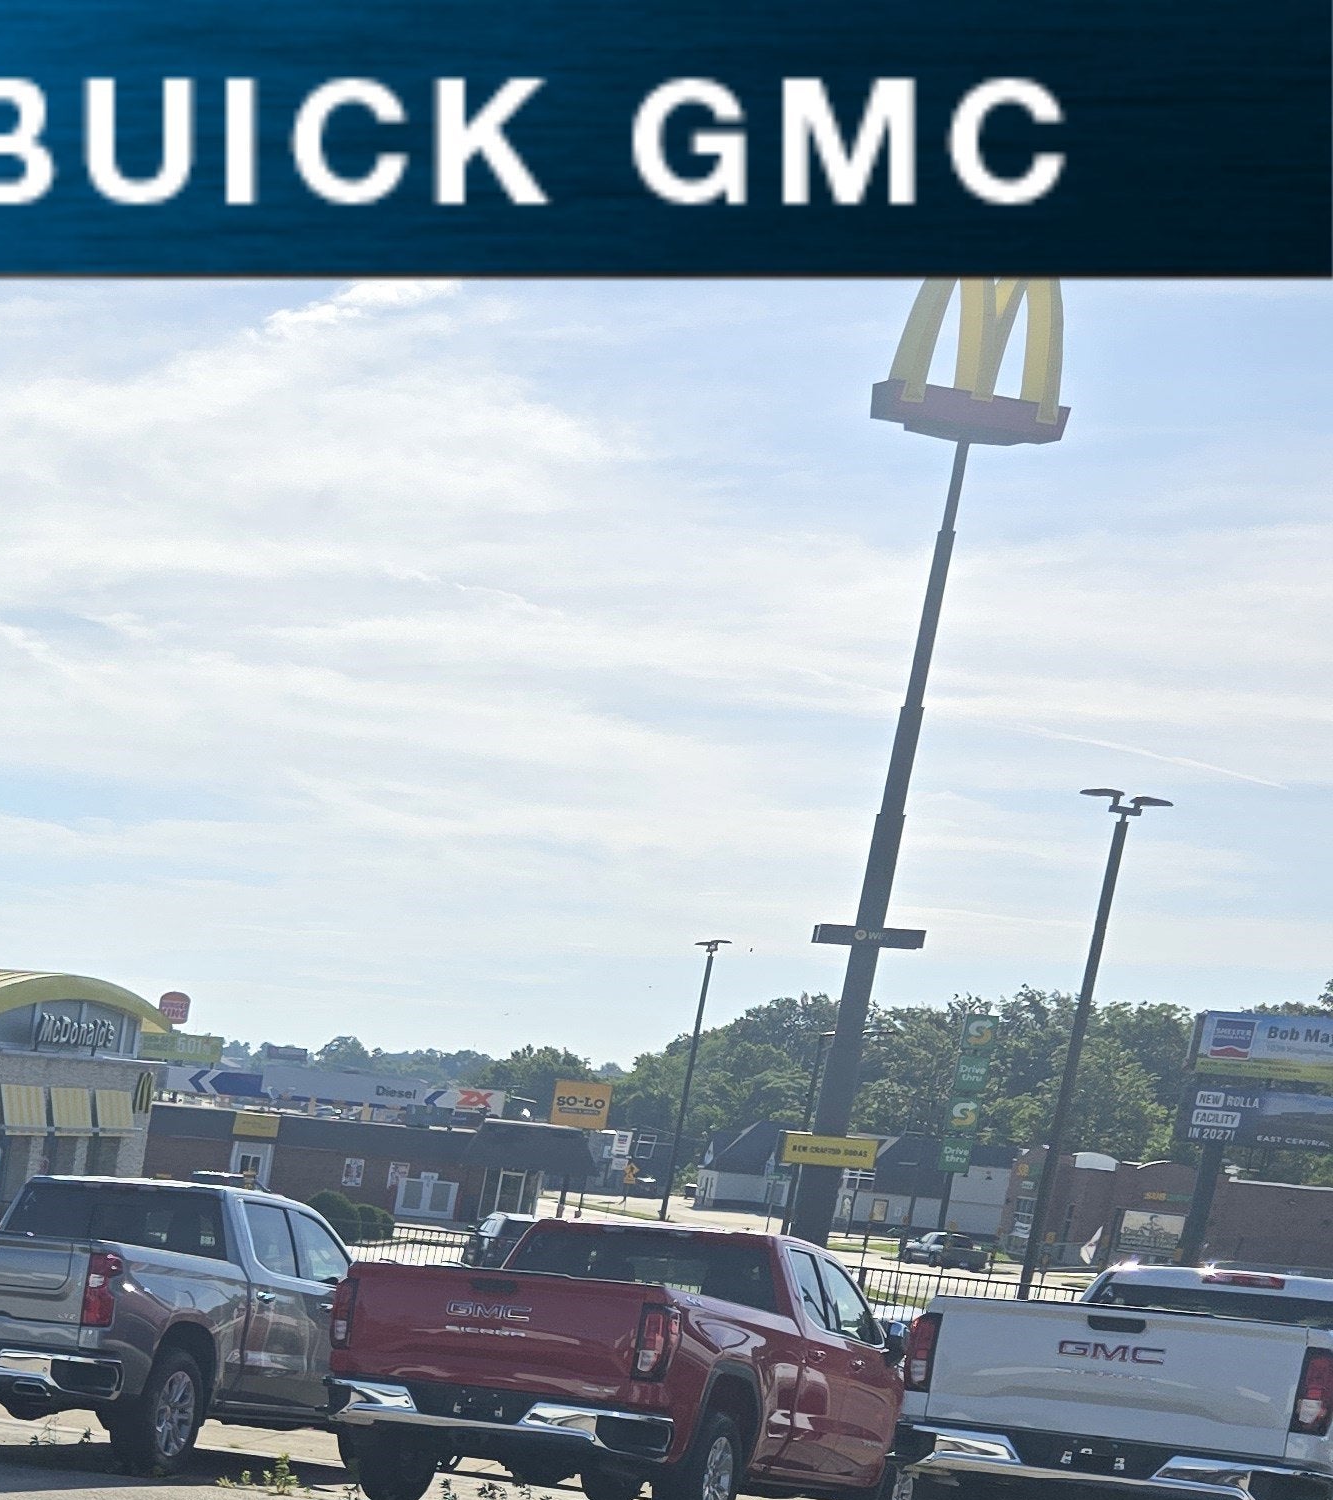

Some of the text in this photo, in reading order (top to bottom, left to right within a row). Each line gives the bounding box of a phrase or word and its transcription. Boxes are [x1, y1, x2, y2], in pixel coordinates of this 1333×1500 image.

[38, 1012, 116, 1048] McDonald's
[1267, 1026, 1300, 1041] Bob
[959, 1064, 986, 1075] Drive
[961, 1073, 983, 1082] thru
[375, 1085, 417, 1100] Diesel
[556, 1096, 605, 1109] SO-LO
[1198, 1093, 1260, 1109] NEW ROLLA
[1195, 1112, 1238, 1126] FACILITY
[1188, 1127, 1200, 1140] IN
[1256, 1135, 1282, 1143] EAST
[943, 1145, 970, 1156] Drive
[945, 1154, 966, 1163] thru
[445, 1300, 532, 1322] GMC
[1057, 1340, 1167, 1366] GMC
